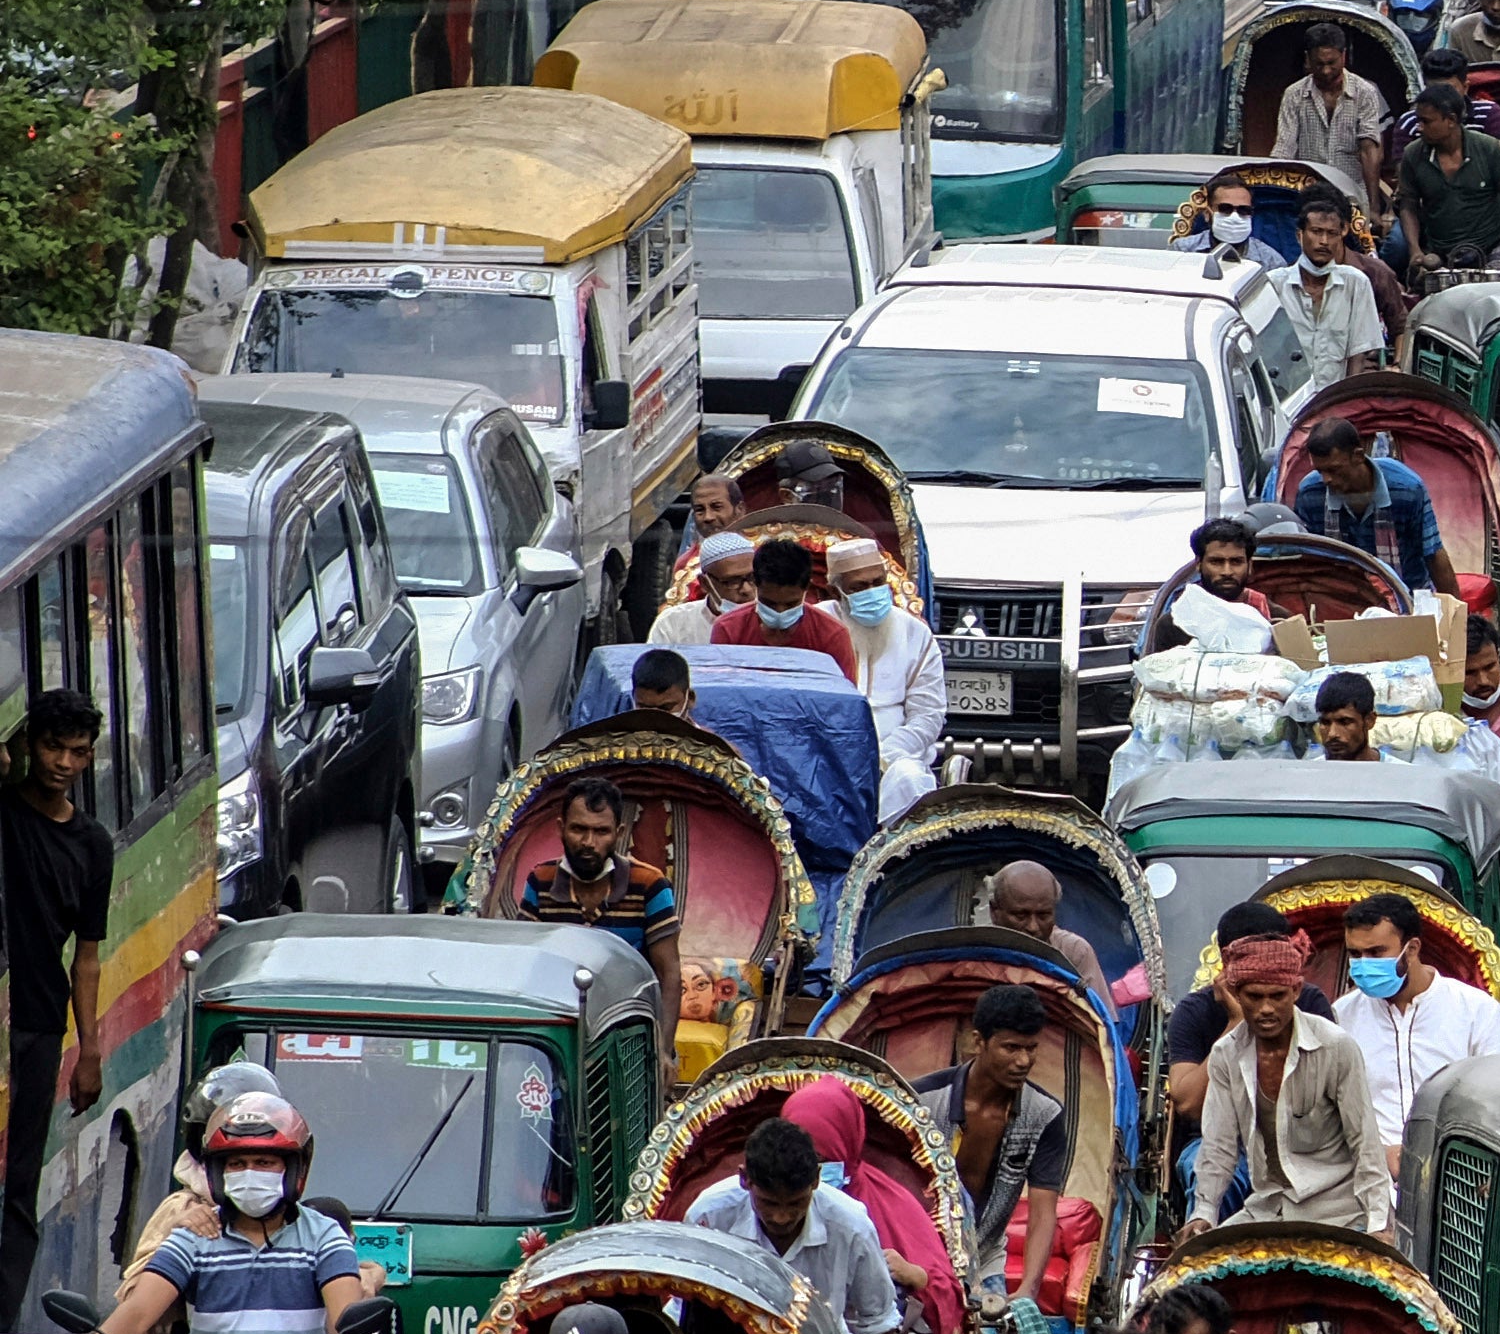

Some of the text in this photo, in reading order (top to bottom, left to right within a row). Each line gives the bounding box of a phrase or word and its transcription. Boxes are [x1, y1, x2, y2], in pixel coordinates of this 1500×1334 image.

[303, 267, 515, 283] REGAL FENCE
[942, 640, 1045, 660] SUBISHI
